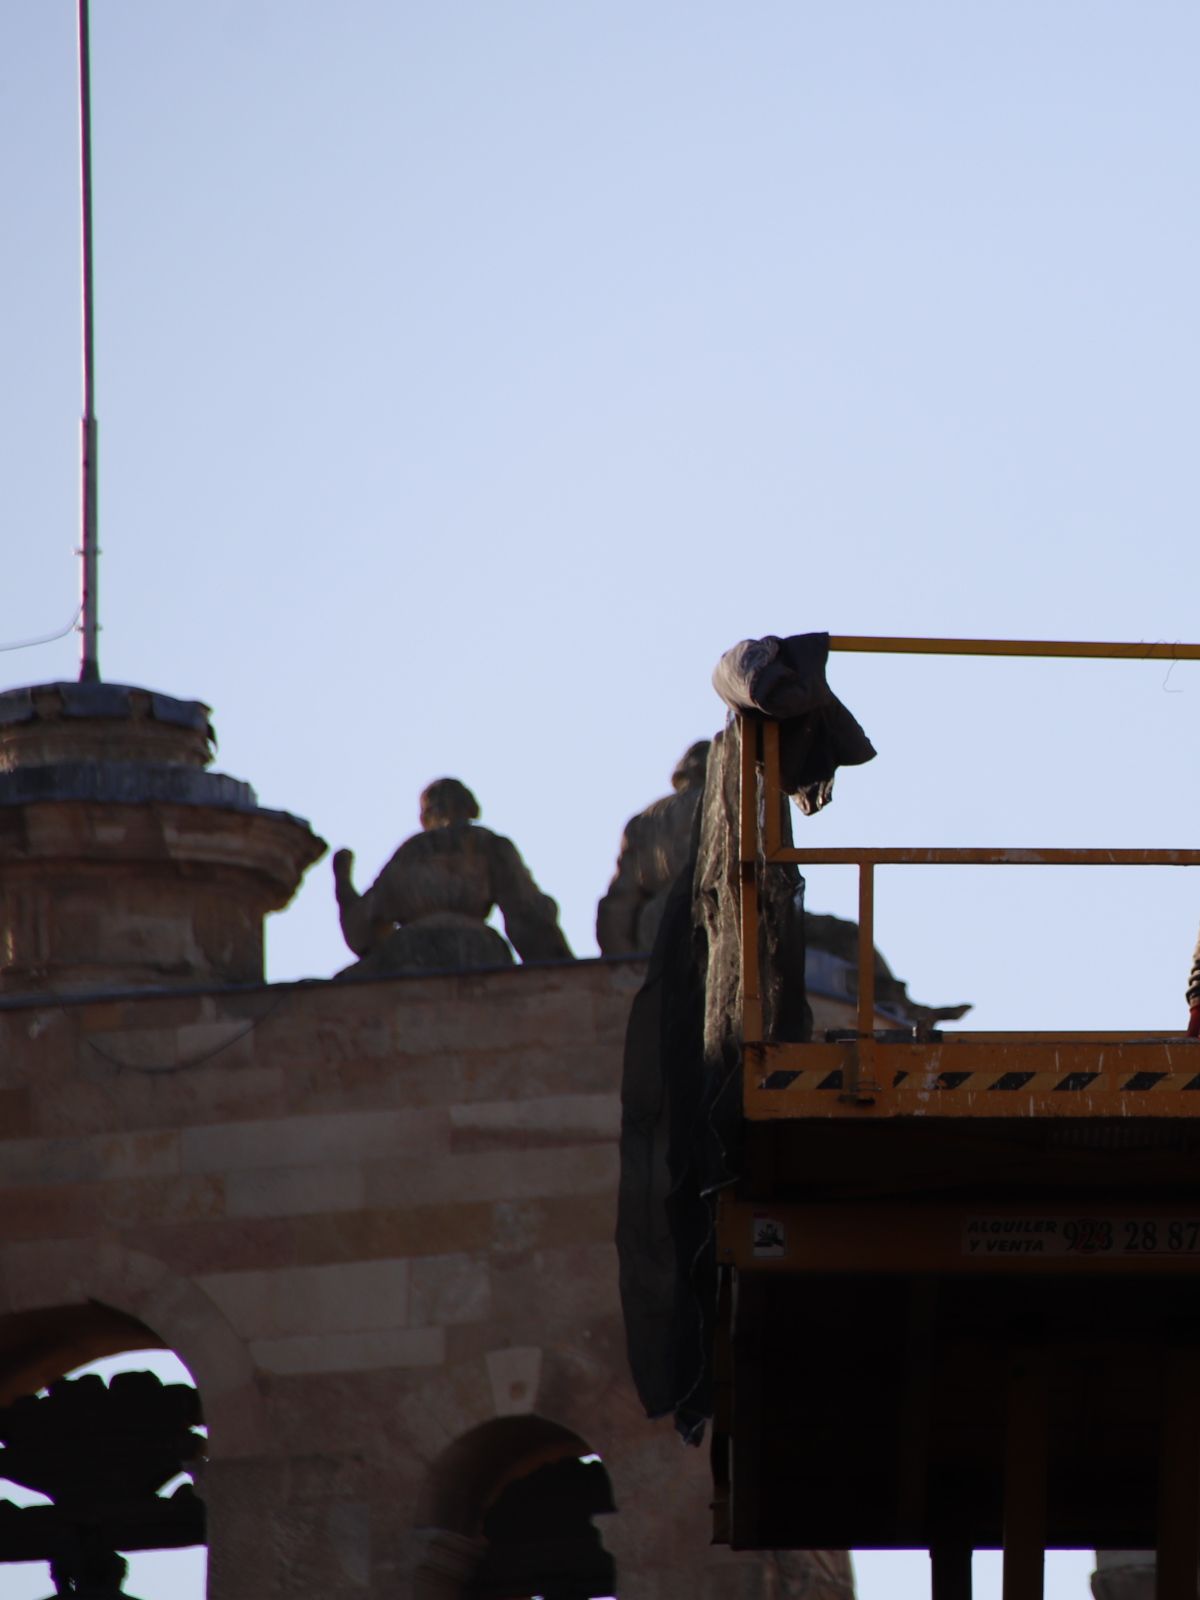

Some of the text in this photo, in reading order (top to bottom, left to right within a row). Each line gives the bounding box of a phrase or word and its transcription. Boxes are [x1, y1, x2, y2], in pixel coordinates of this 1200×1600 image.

[967, 1220, 1058, 1233] ALQUILER
[1062, 1221, 1113, 1251] 923
[1122, 1221, 1159, 1251] 28
[1167, 1221, 1200, 1251] 87
[968, 1239, 1045, 1252] Y VENTA
